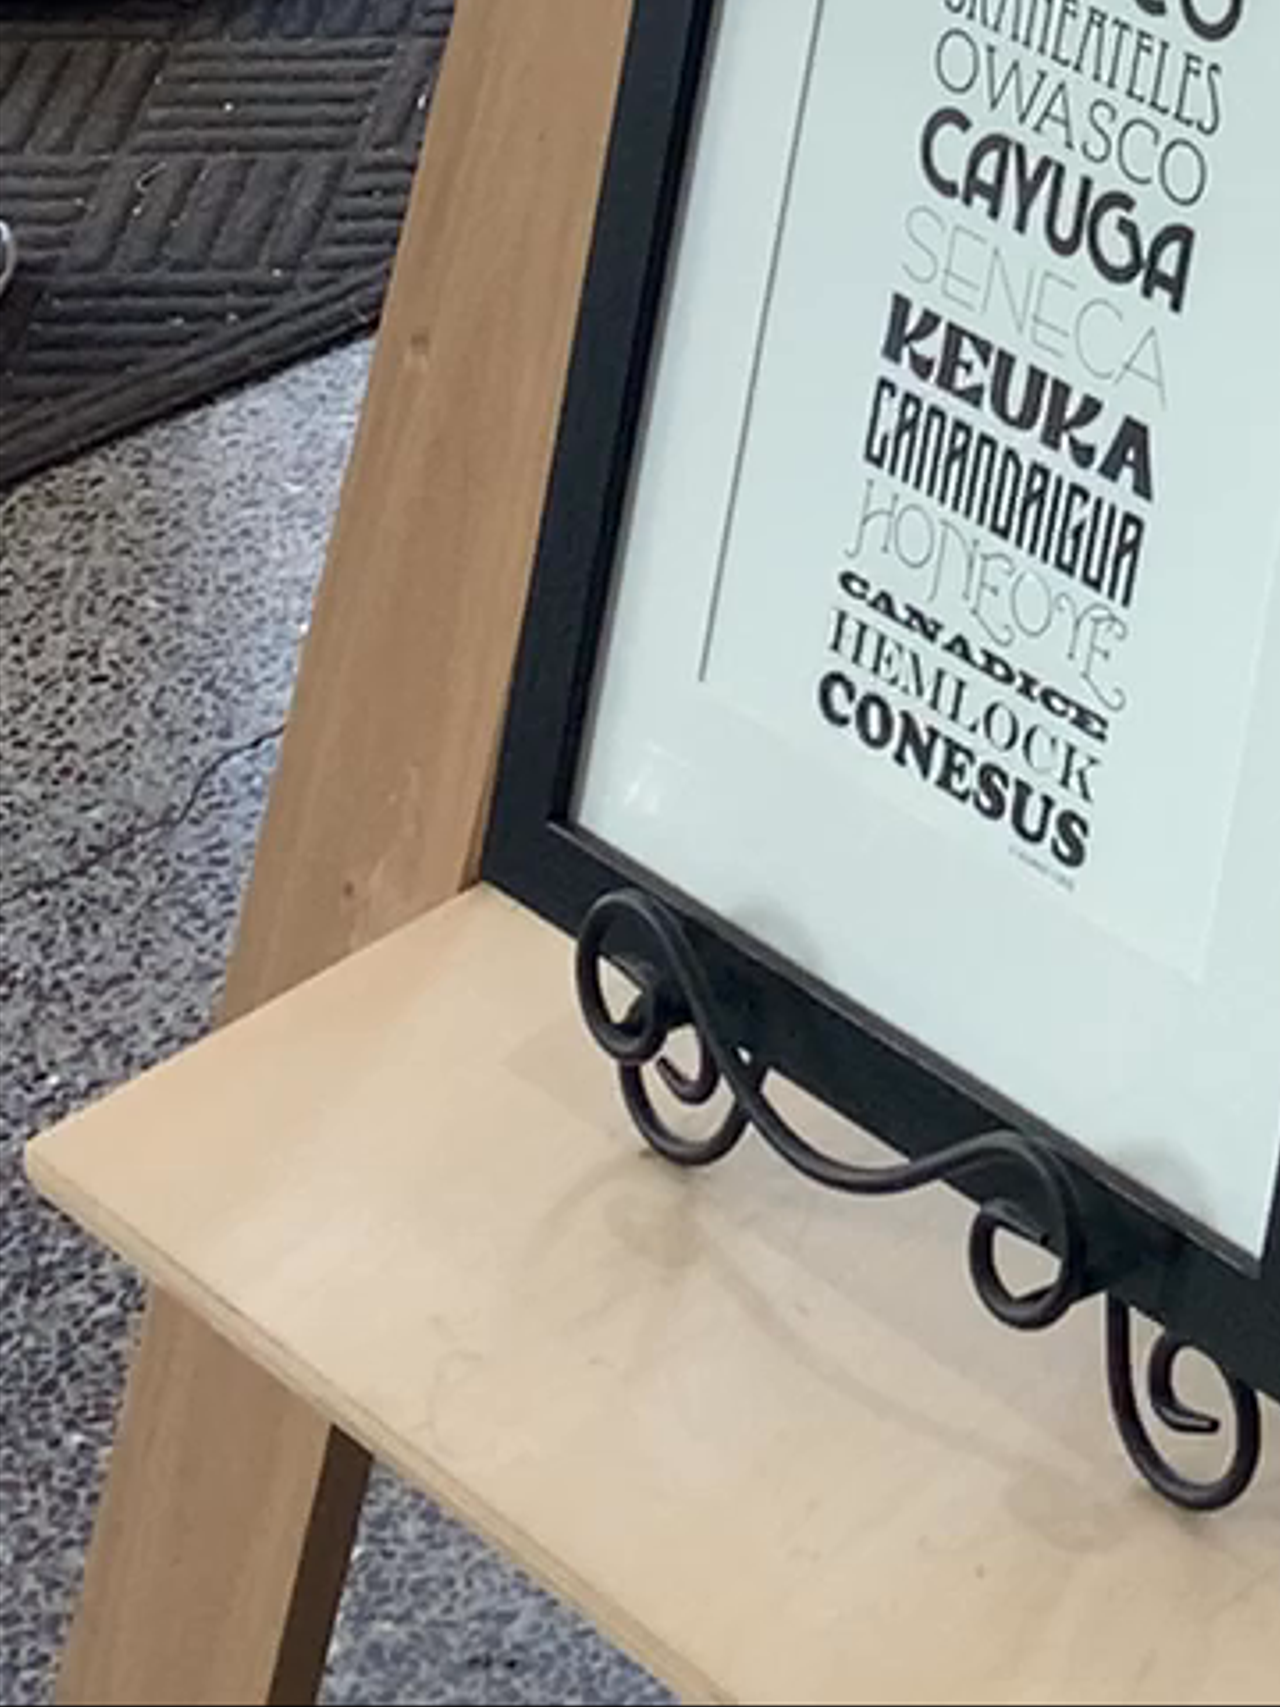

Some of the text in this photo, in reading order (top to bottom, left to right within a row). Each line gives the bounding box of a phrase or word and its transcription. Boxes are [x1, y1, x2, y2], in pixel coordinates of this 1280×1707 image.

[920, 106, 1195, 313] CAYUGA
[936, 26, 1207, 207] OWASCO
[881, 292, 1154, 502] KEUKA
[900, 203, 1166, 408] SENECA
[844, 477, 1128, 713] HONEOYE
[864, 376, 1145, 609] CANANDAIGUA
[826, 606, 1104, 802] HEMLOCK
[837, 569, 1110, 744] CANADICE
[818, 671, 1090, 869] CONESUS
